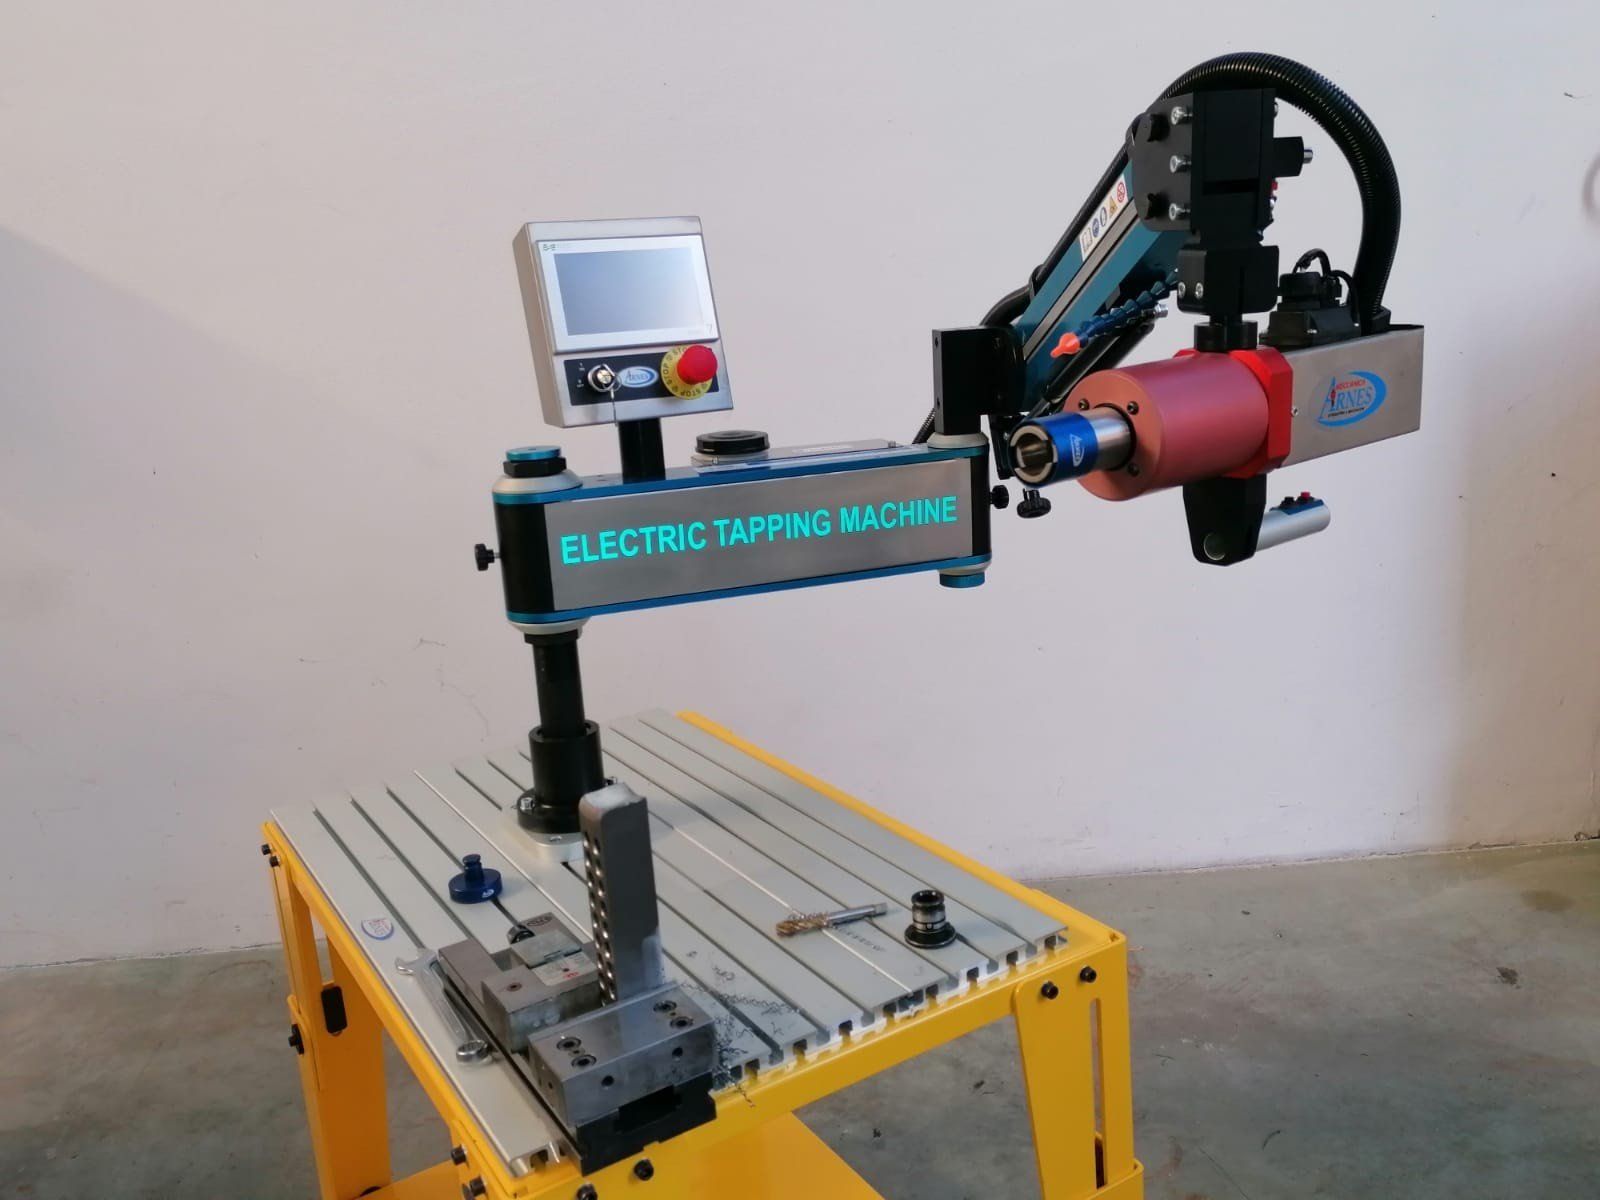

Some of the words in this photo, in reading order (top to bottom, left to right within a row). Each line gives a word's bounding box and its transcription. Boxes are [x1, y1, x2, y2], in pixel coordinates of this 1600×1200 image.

[560, 521, 707, 565] ELECTRIC
[713, 509, 832, 547] TAPPING
[839, 496, 957, 534] MACHINE
